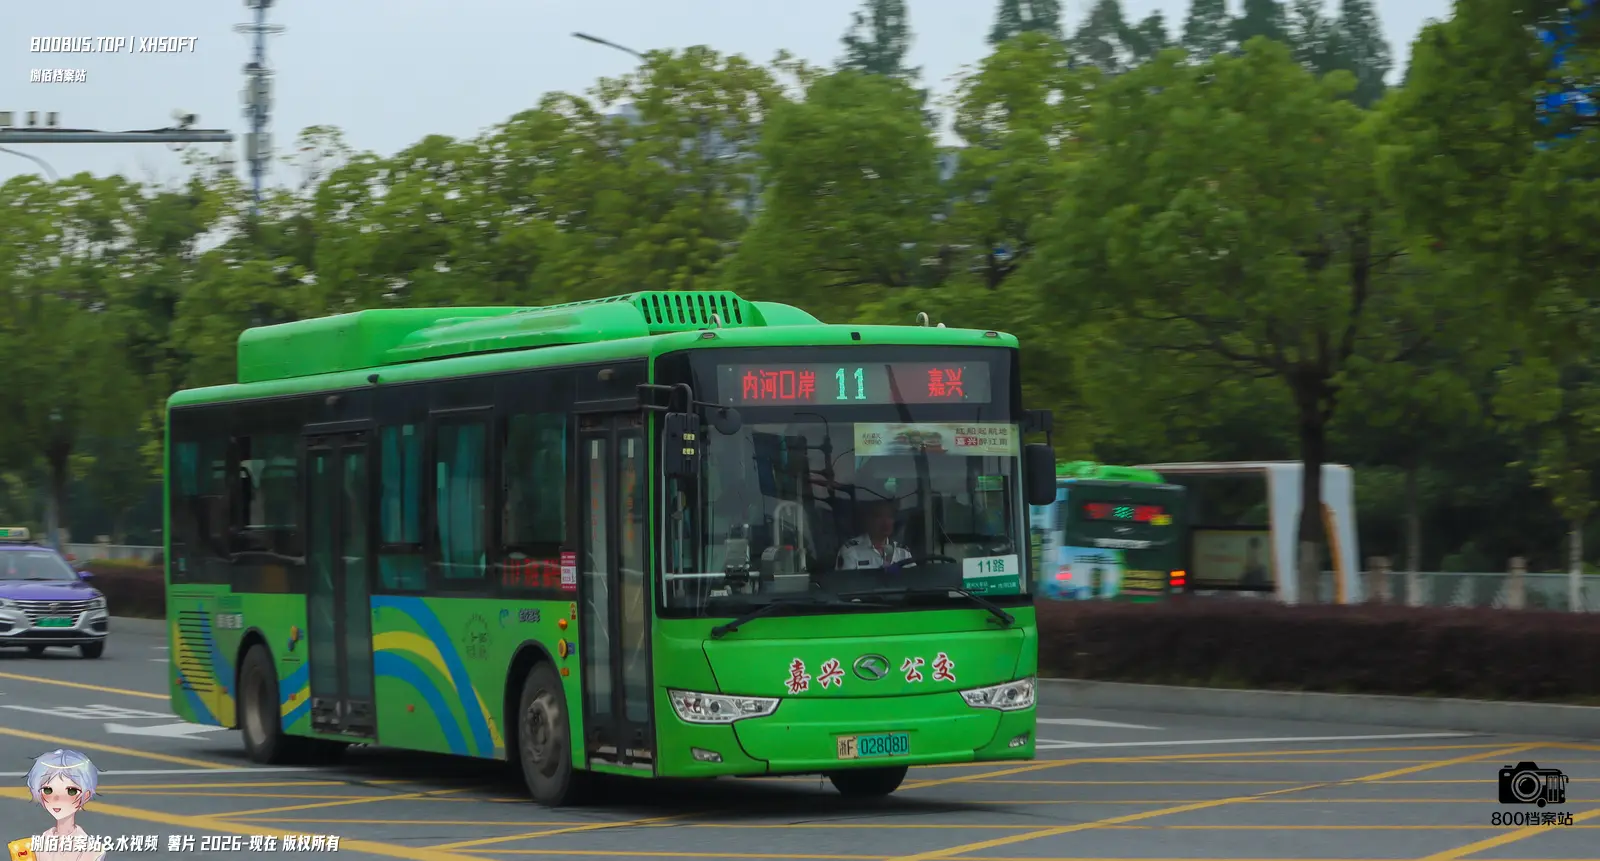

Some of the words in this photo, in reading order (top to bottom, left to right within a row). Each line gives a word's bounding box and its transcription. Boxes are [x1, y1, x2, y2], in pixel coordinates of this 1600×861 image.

[742, 370, 816, 400] 内河口岸
[835, 368, 867, 400] 11
[927, 368, 964, 397] 嘉兴
[977, 559, 1005, 573] 11路
[785, 657, 845, 694] 嘉兴
[900, 652, 956, 683] 公交
